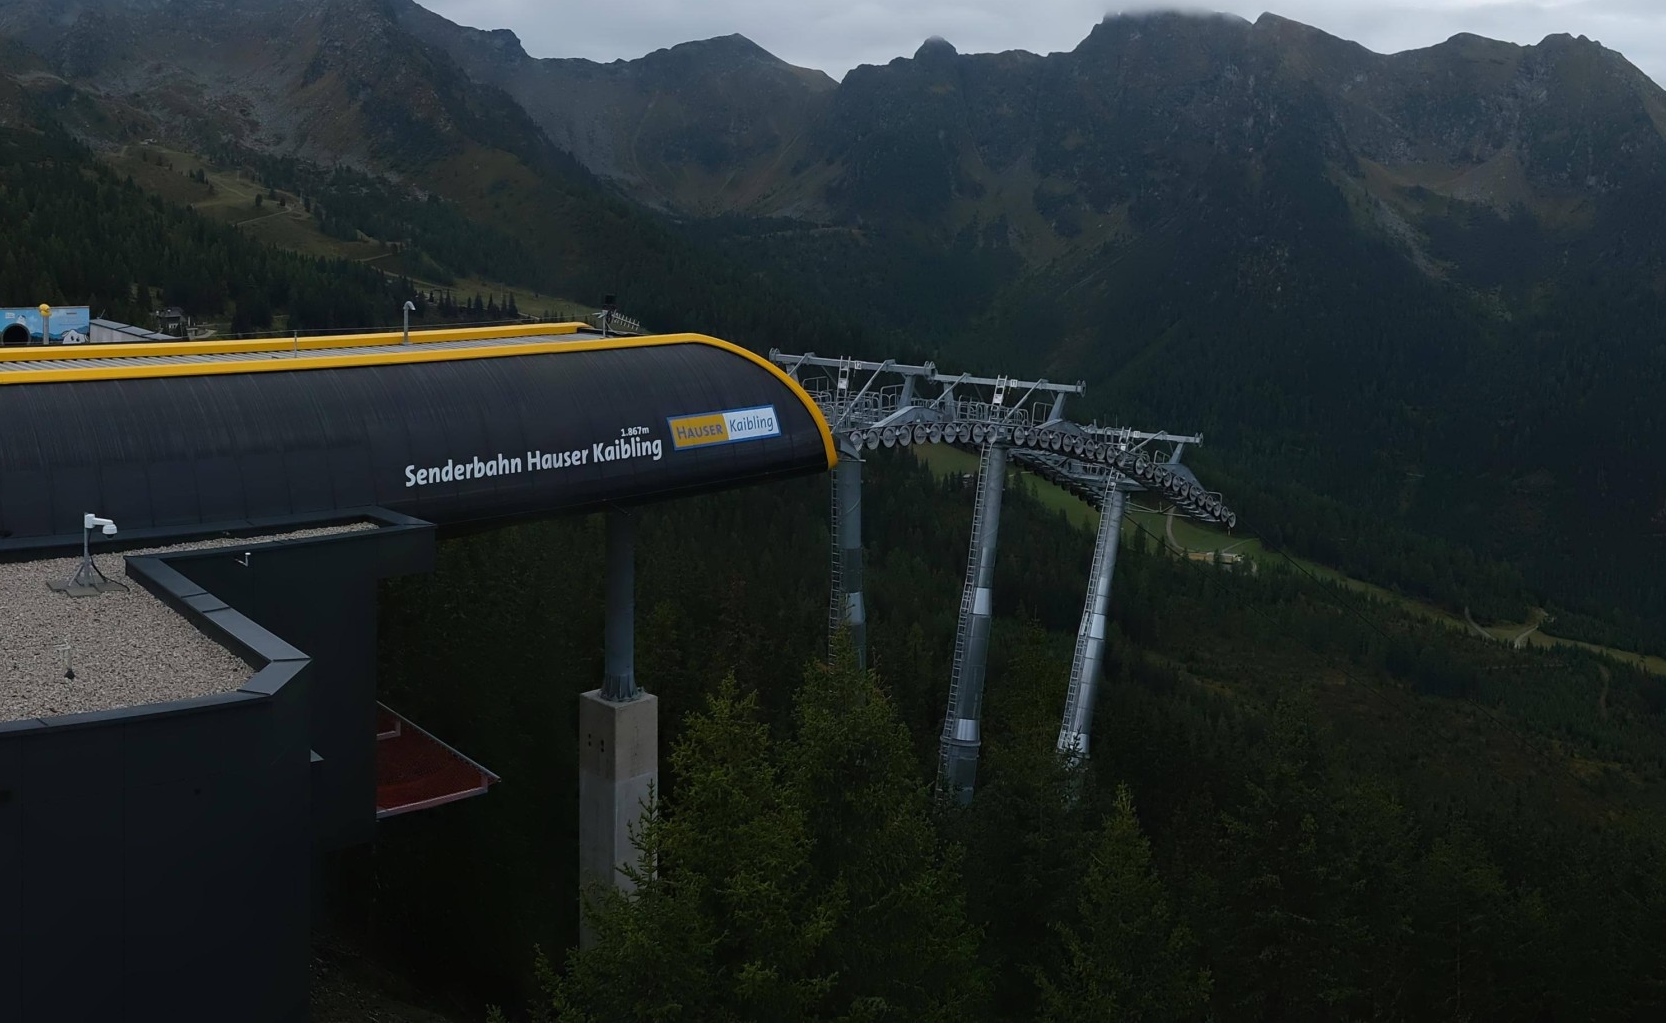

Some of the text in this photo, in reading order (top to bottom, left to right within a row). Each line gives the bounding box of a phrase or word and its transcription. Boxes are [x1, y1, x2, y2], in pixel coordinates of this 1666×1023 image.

[620, 426, 650, 437] 1.867m
[676, 415, 774, 440] HAUSER Kaibling
[405, 437, 662, 488] Senderbahn Hauser Kaibling
